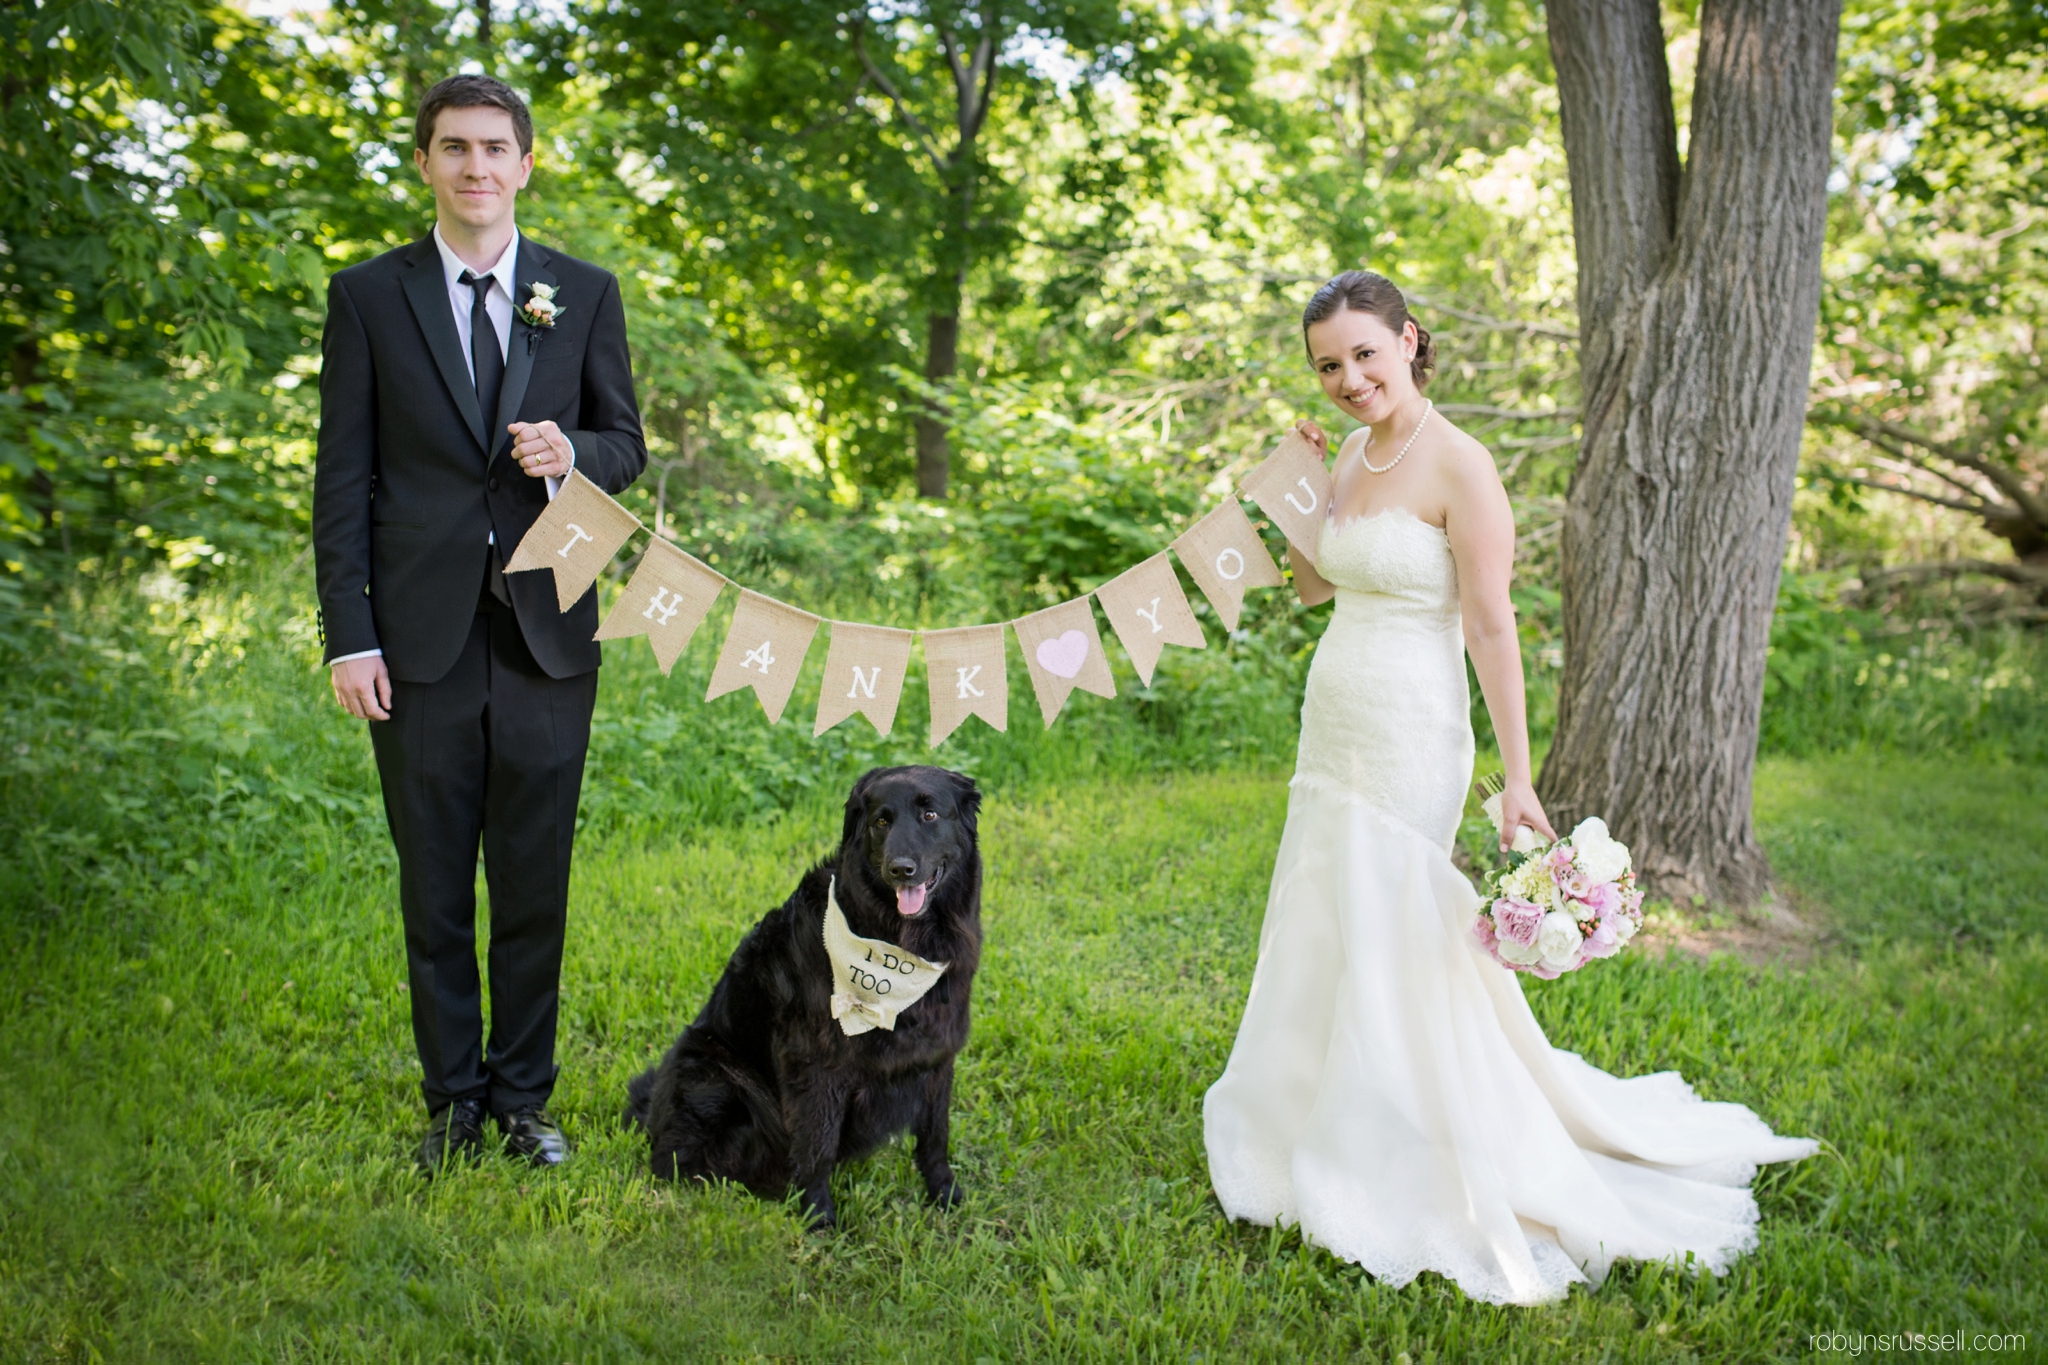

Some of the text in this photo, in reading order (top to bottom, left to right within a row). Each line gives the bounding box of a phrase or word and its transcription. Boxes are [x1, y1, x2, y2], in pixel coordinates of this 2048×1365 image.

[865, 948, 915, 974] I DO
[849, 964, 892, 995] TOO
